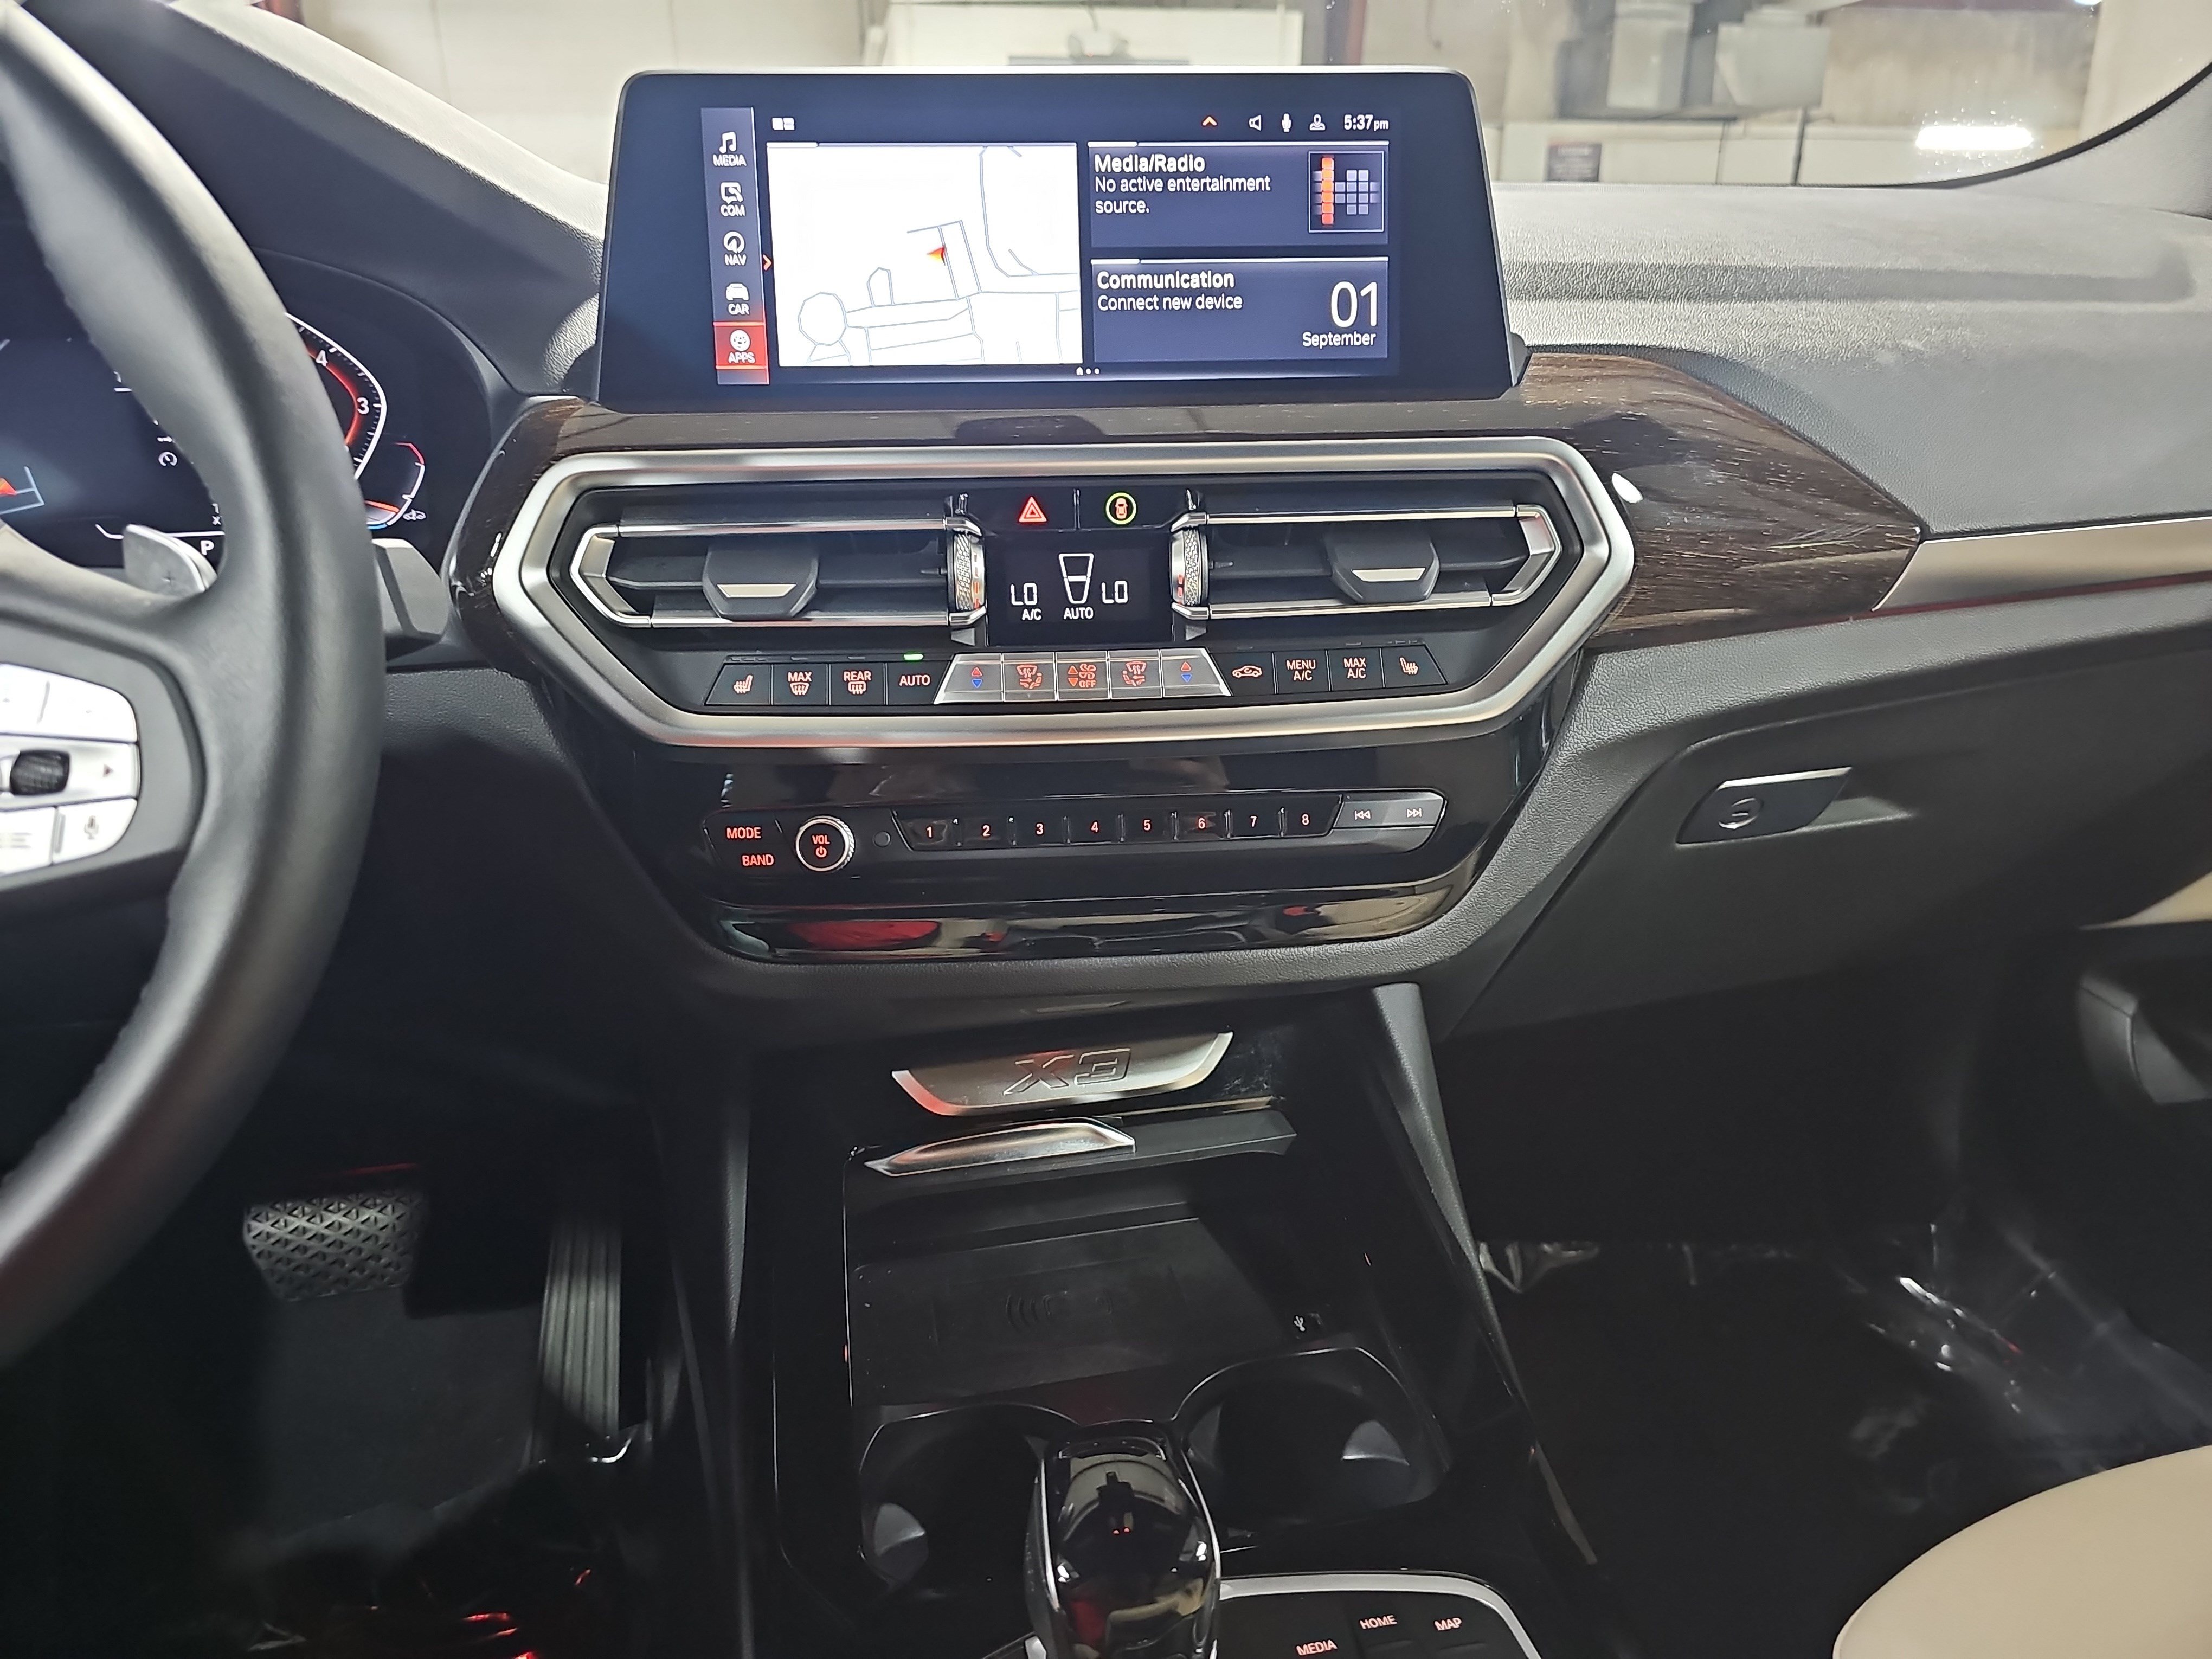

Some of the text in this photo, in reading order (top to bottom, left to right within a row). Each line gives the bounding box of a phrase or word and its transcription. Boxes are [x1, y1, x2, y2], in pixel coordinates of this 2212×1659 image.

[712, 154, 747, 166] MEDIA
[1094, 153, 1205, 173] Media/Radio
[1095, 175, 1271, 192] No active entertainment
[720, 205, 745, 217] COM
[1095, 198, 1150, 214] source.
[724, 254, 747, 266] NAV
[1096, 270, 1235, 290] Communication
[1097, 293, 1243, 312] Connect new device
[1330, 281, 1379, 328] 01
[728, 303, 750, 316] CAR
[1302, 331, 1377, 349] September
[316, 350, 328, 367] 4
[728, 352, 755, 364] APPS
[357, 397, 370, 414] 3
[200, 540, 214, 556] P
[1022, 608, 1041, 621] A/C
[1063, 607, 1094, 620] AUTO
[1286, 659, 1316, 671] MENU
[1343, 657, 1367, 669] MAX
[788, 671, 812, 682] MAX
[844, 670, 872, 682] REAR
[899, 674, 931, 686] AUTO
[1293, 670, 1314, 681] A/C
[1347, 667, 1367, 680] A/C
[1079, 679, 1096, 688] OFF
[1143, 819, 1152, 832] 5
[1198, 817, 1206, 830] 6
[1250, 815, 1258, 828] 7
[1301, 813, 1310, 826] 8
[726, 827, 762, 840] MODE
[927, 826, 933, 838] 1
[982, 825, 991, 837] 2
[1036, 822, 1044, 835] 3
[1091, 821, 1099, 833] 4
[812, 834, 831, 845] VOL
[742, 854, 774, 867] BAND
[1002, 1047, 1131, 1096] X3
[1359, 1615, 1398, 1630] HOME
[1434, 1617, 1462, 1631] MAP
[1295, 1639, 1338, 1656] MEDIA
